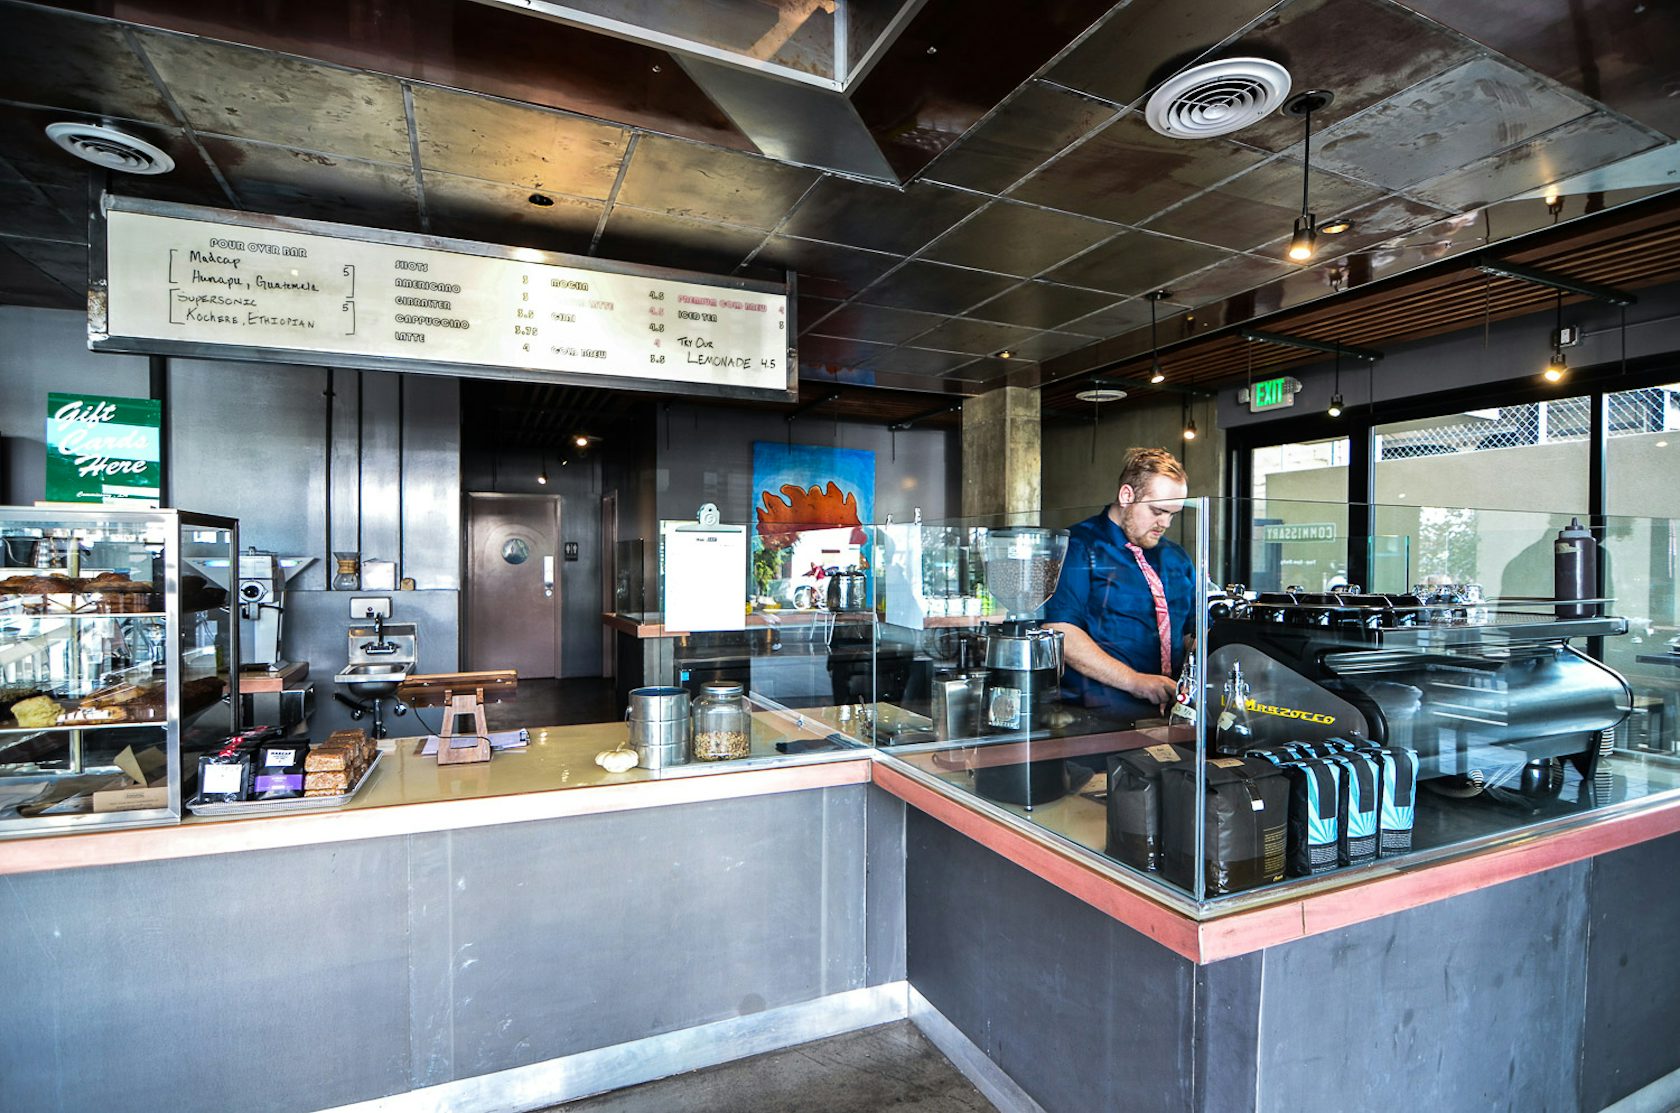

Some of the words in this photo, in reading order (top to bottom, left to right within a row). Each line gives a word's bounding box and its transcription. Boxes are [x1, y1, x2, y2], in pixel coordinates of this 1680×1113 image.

[210, 238, 245, 251] POUR
[248, 242, 281, 255] OVER
[282, 245, 308, 258] BAR
[343, 267, 350, 276] 5
[395, 260, 429, 272] SHOTS
[395, 277, 461, 293] AMERICANO
[550, 278, 589, 291] MOCHA
[342, 304, 349, 312] 5
[395, 313, 470, 329] CAPPUCCINO
[678, 310, 700, 321] ICED
[701, 313, 718, 323] TEA
[395, 331, 425, 343] LATTE
[687, 351, 751, 369] LEMONADE
[1256, 378, 1285, 407] EXIT
[54, 400, 117, 432] Gift
[58, 428, 149, 455] Cards
[74, 453, 148, 478] Here
